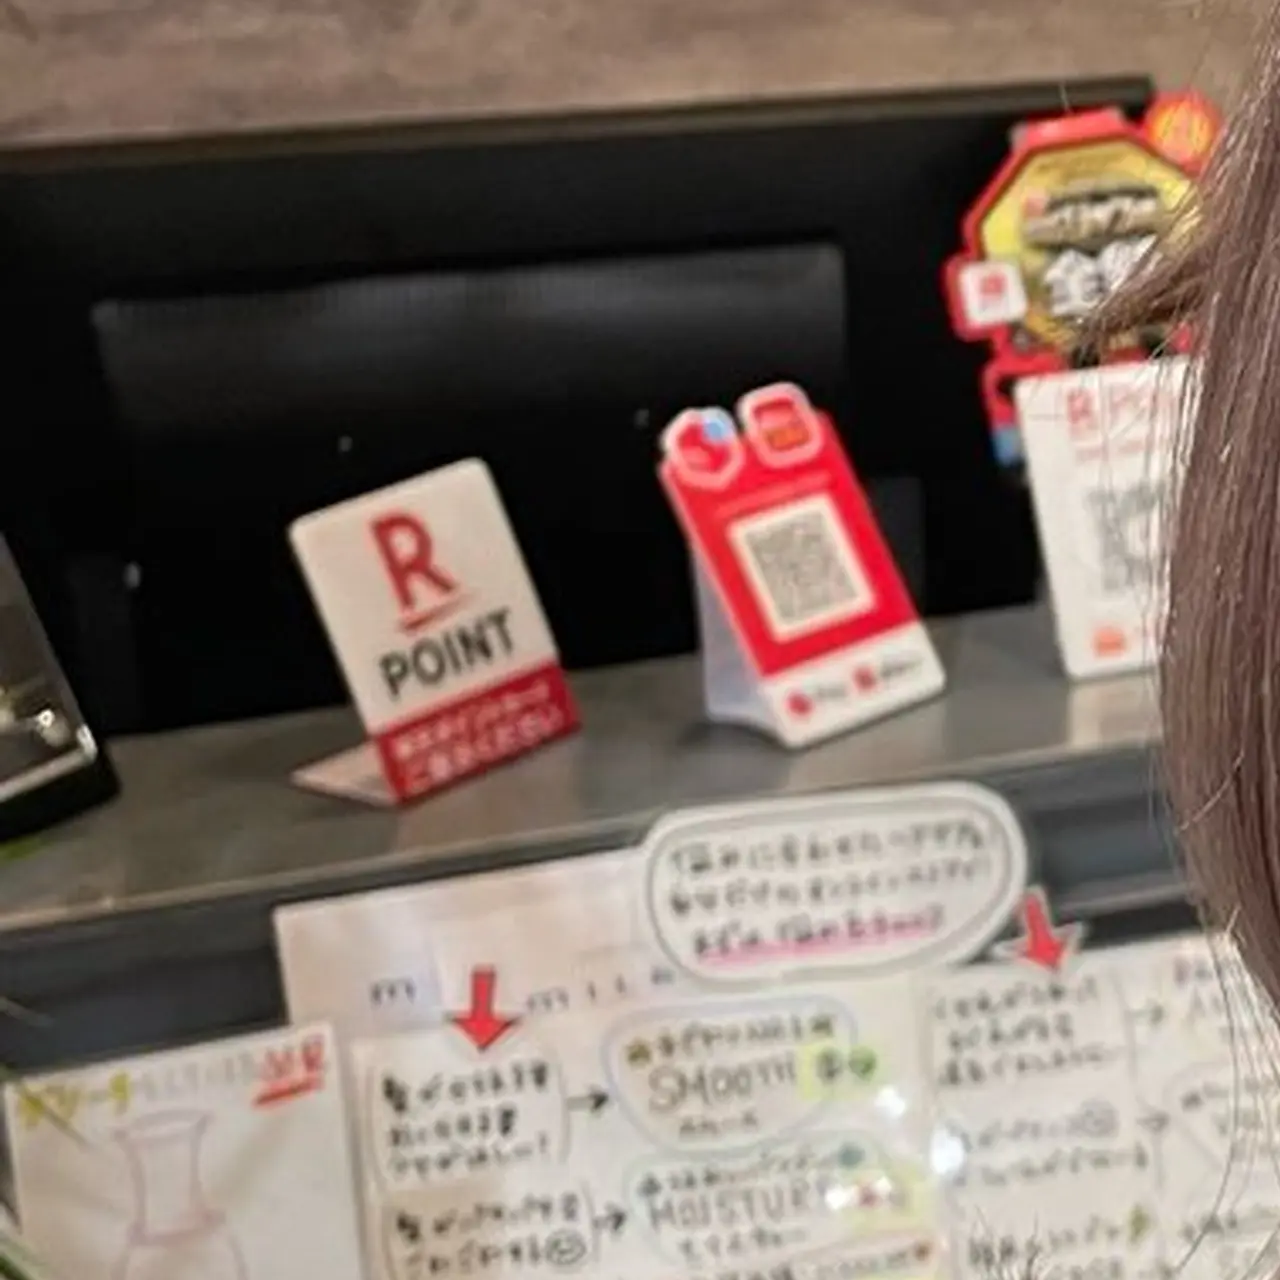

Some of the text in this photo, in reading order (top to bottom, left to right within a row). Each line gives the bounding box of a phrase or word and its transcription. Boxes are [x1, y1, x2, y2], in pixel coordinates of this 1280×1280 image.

[371, 512, 458, 608] R
[378, 608, 515, 700] POINT
[648, 1048, 797, 1112] SMOOTH
